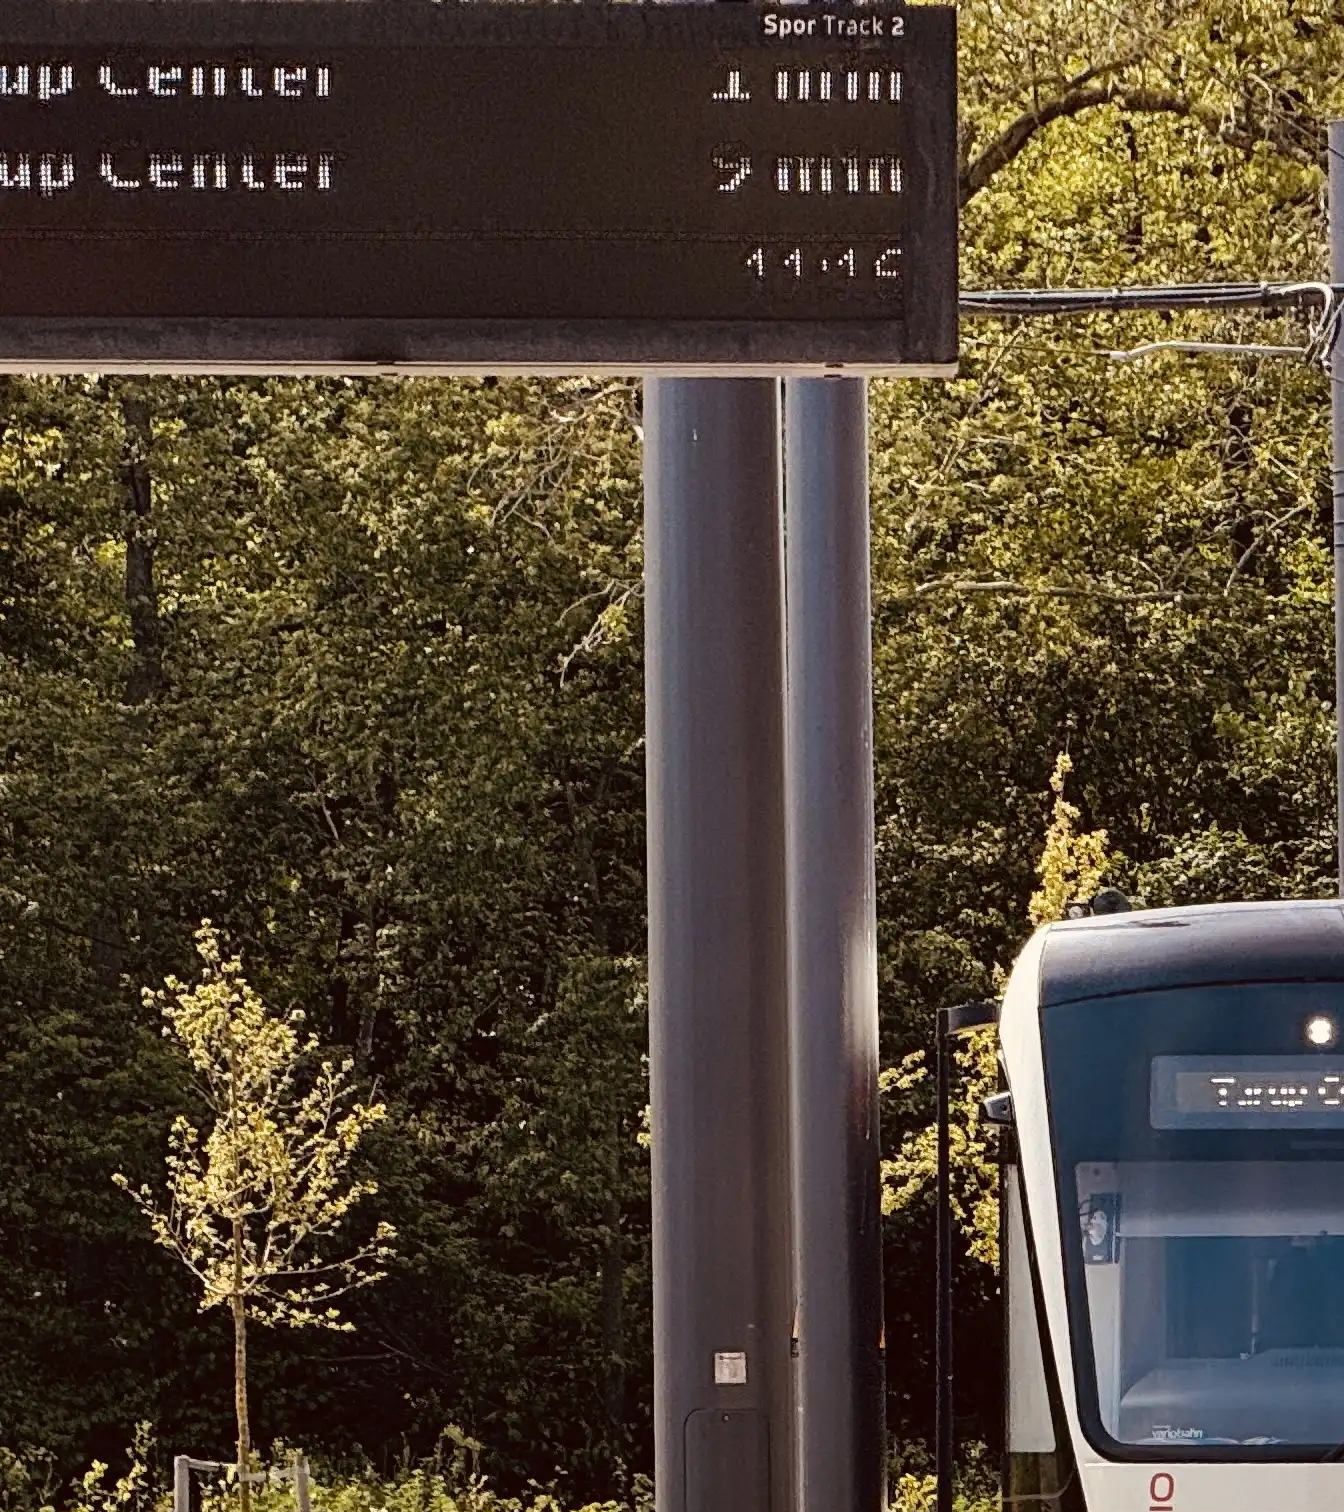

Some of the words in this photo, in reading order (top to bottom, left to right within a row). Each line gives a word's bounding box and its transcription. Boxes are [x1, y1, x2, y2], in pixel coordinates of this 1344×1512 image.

[763, 13, 817, 39] Spor
[822, 14, 884, 36] Track
[891, 16, 905, 36] 2
